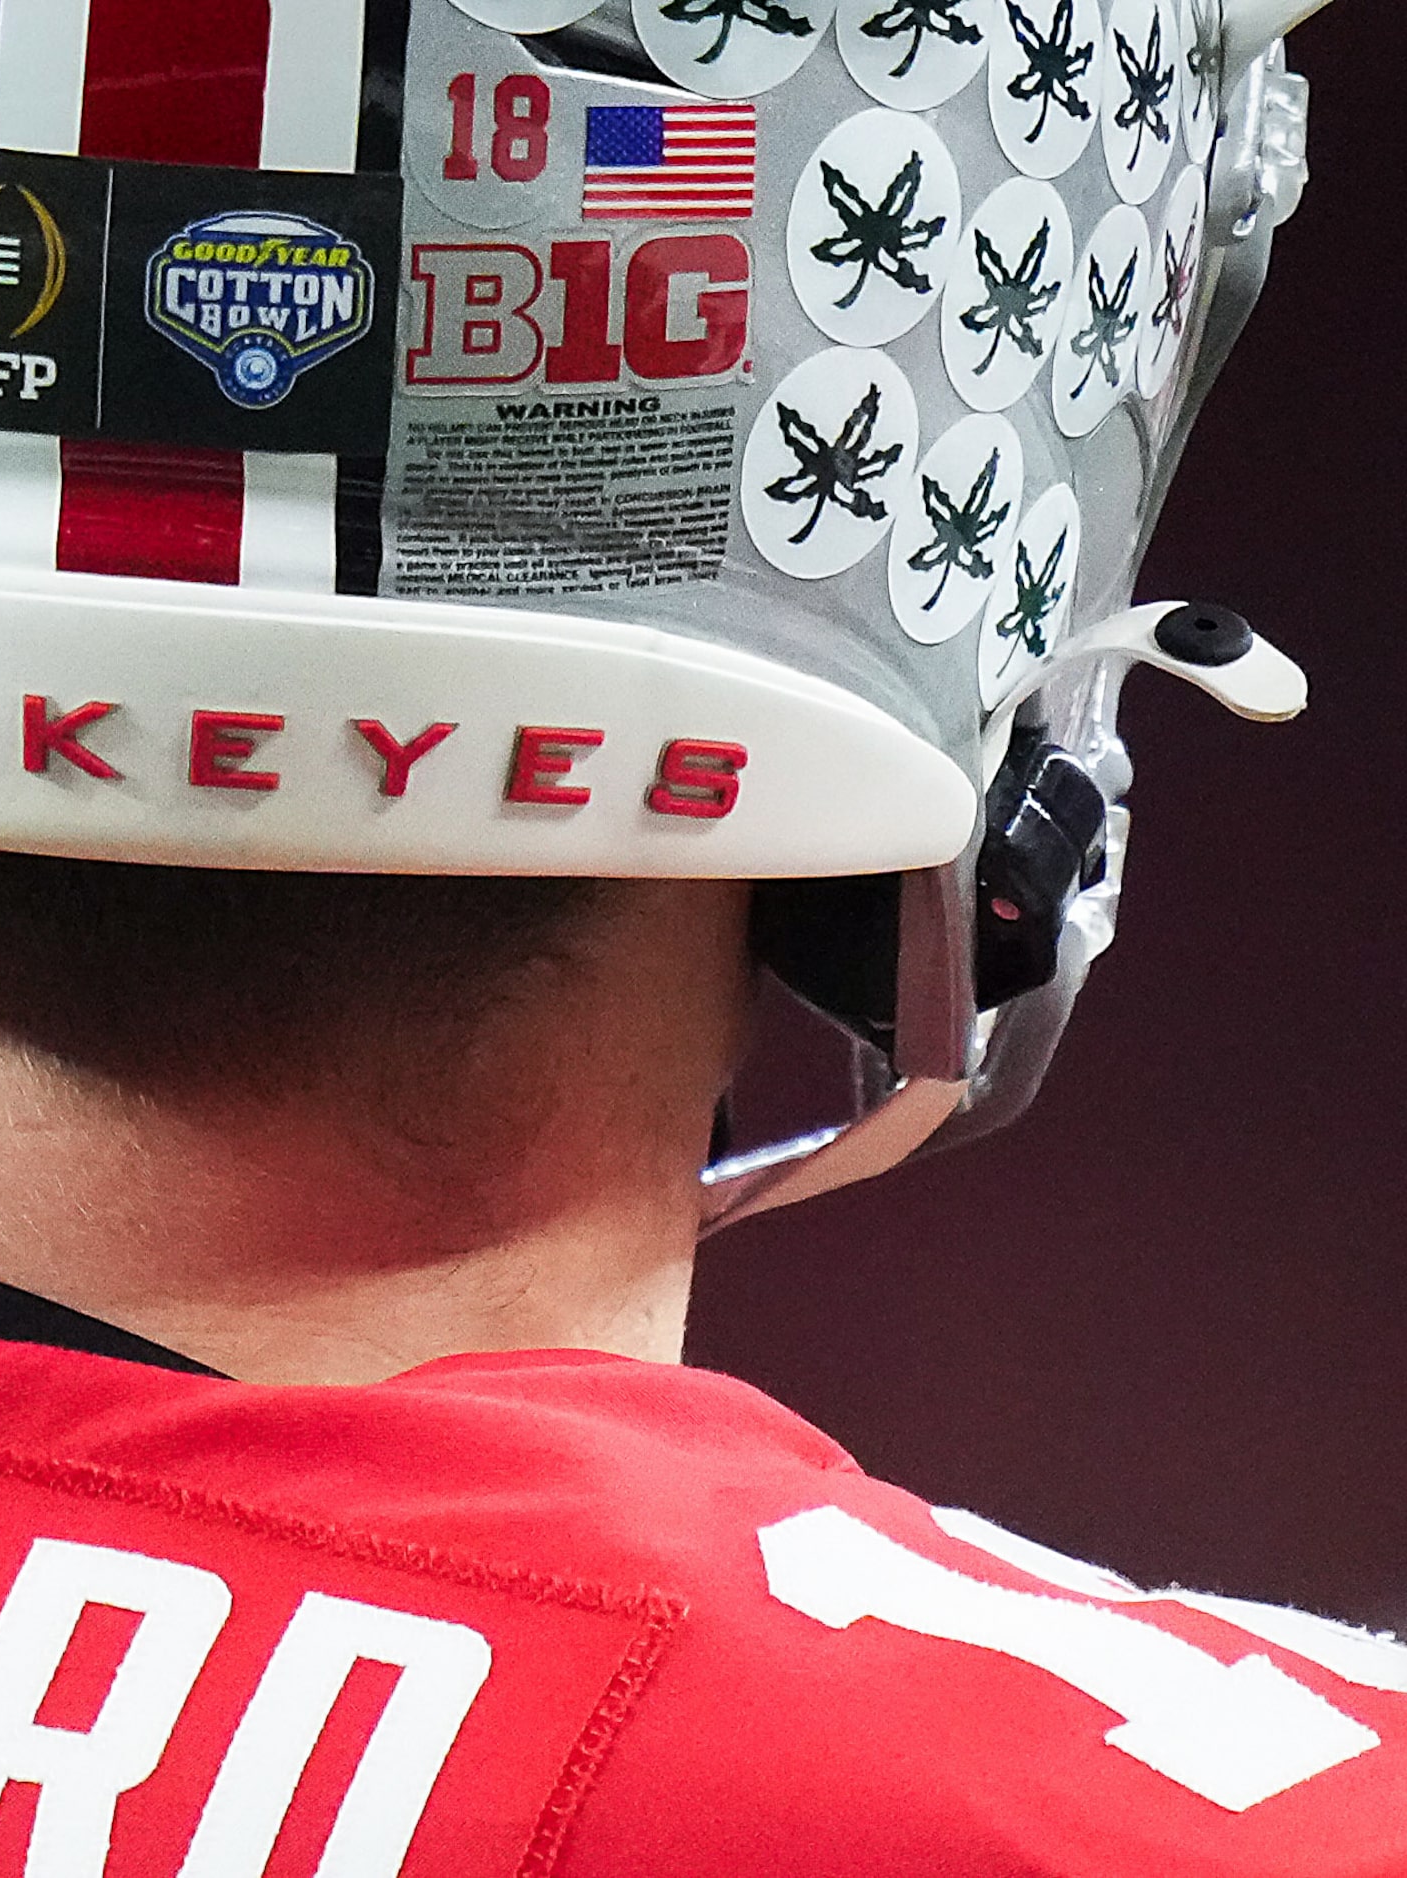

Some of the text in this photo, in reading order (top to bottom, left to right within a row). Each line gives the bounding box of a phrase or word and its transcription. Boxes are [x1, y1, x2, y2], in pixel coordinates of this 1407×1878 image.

[443, 72, 551, 182] 18
[165, 268, 355, 330] COTTON
[199, 303, 318, 342] BOWL
[496, 397, 661, 421] WARNING
